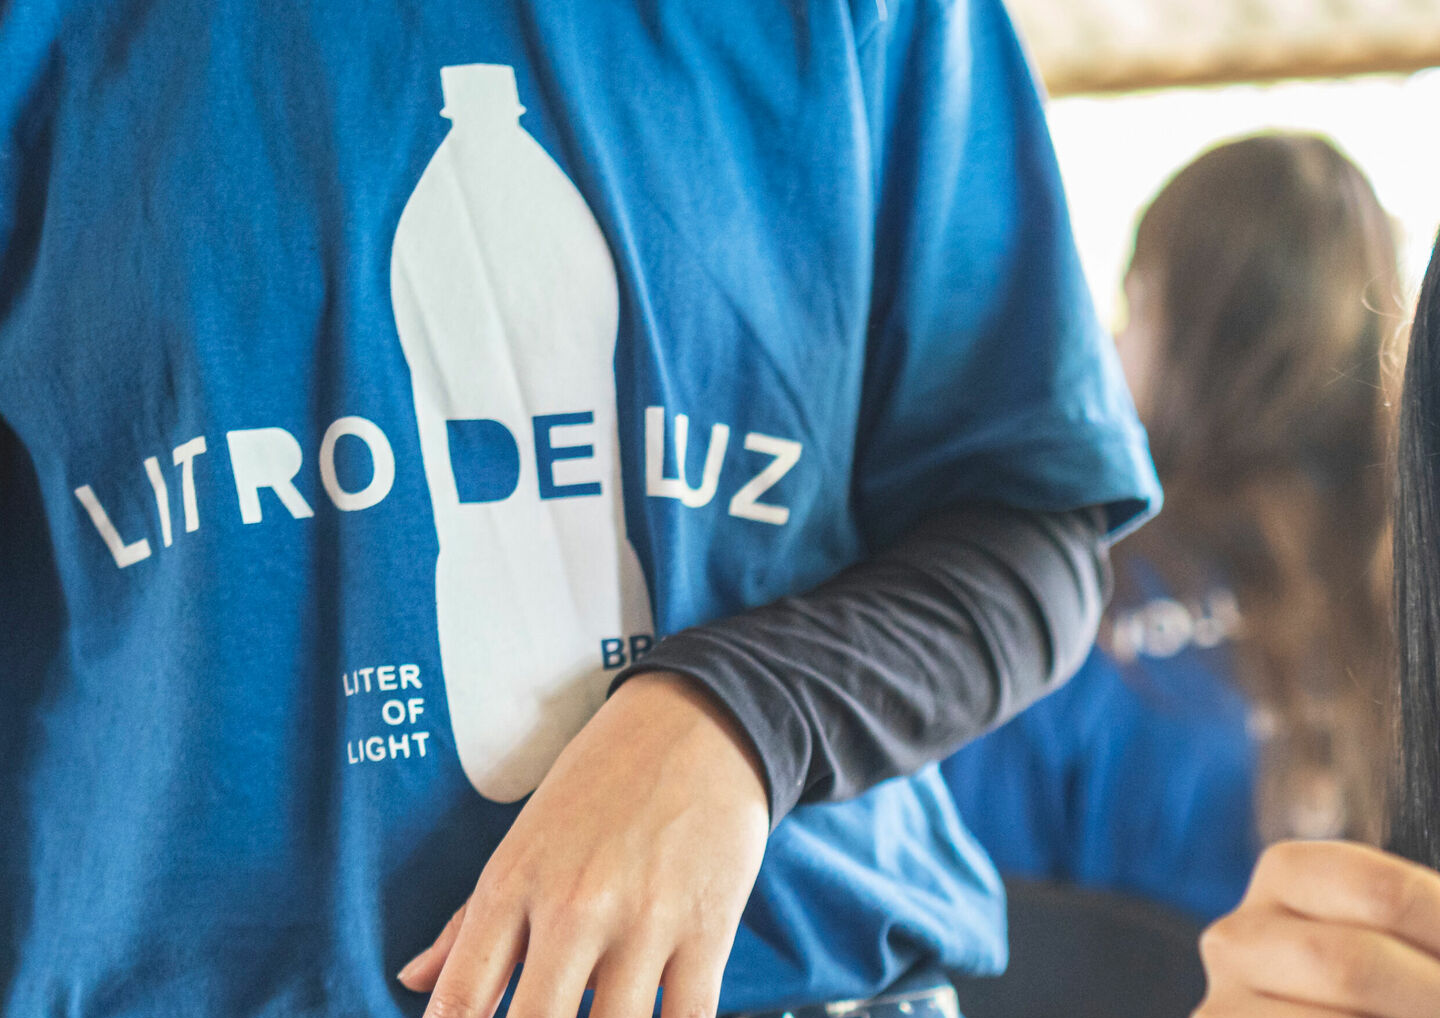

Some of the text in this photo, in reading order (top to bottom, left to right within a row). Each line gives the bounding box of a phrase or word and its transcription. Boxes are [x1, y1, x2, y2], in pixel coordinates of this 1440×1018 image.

[75, 405, 803, 569] LITRO DE LUZ
[343, 664, 422, 696] LITER
[381, 697, 425, 726] OF
[347, 731, 430, 764] LIGHT
